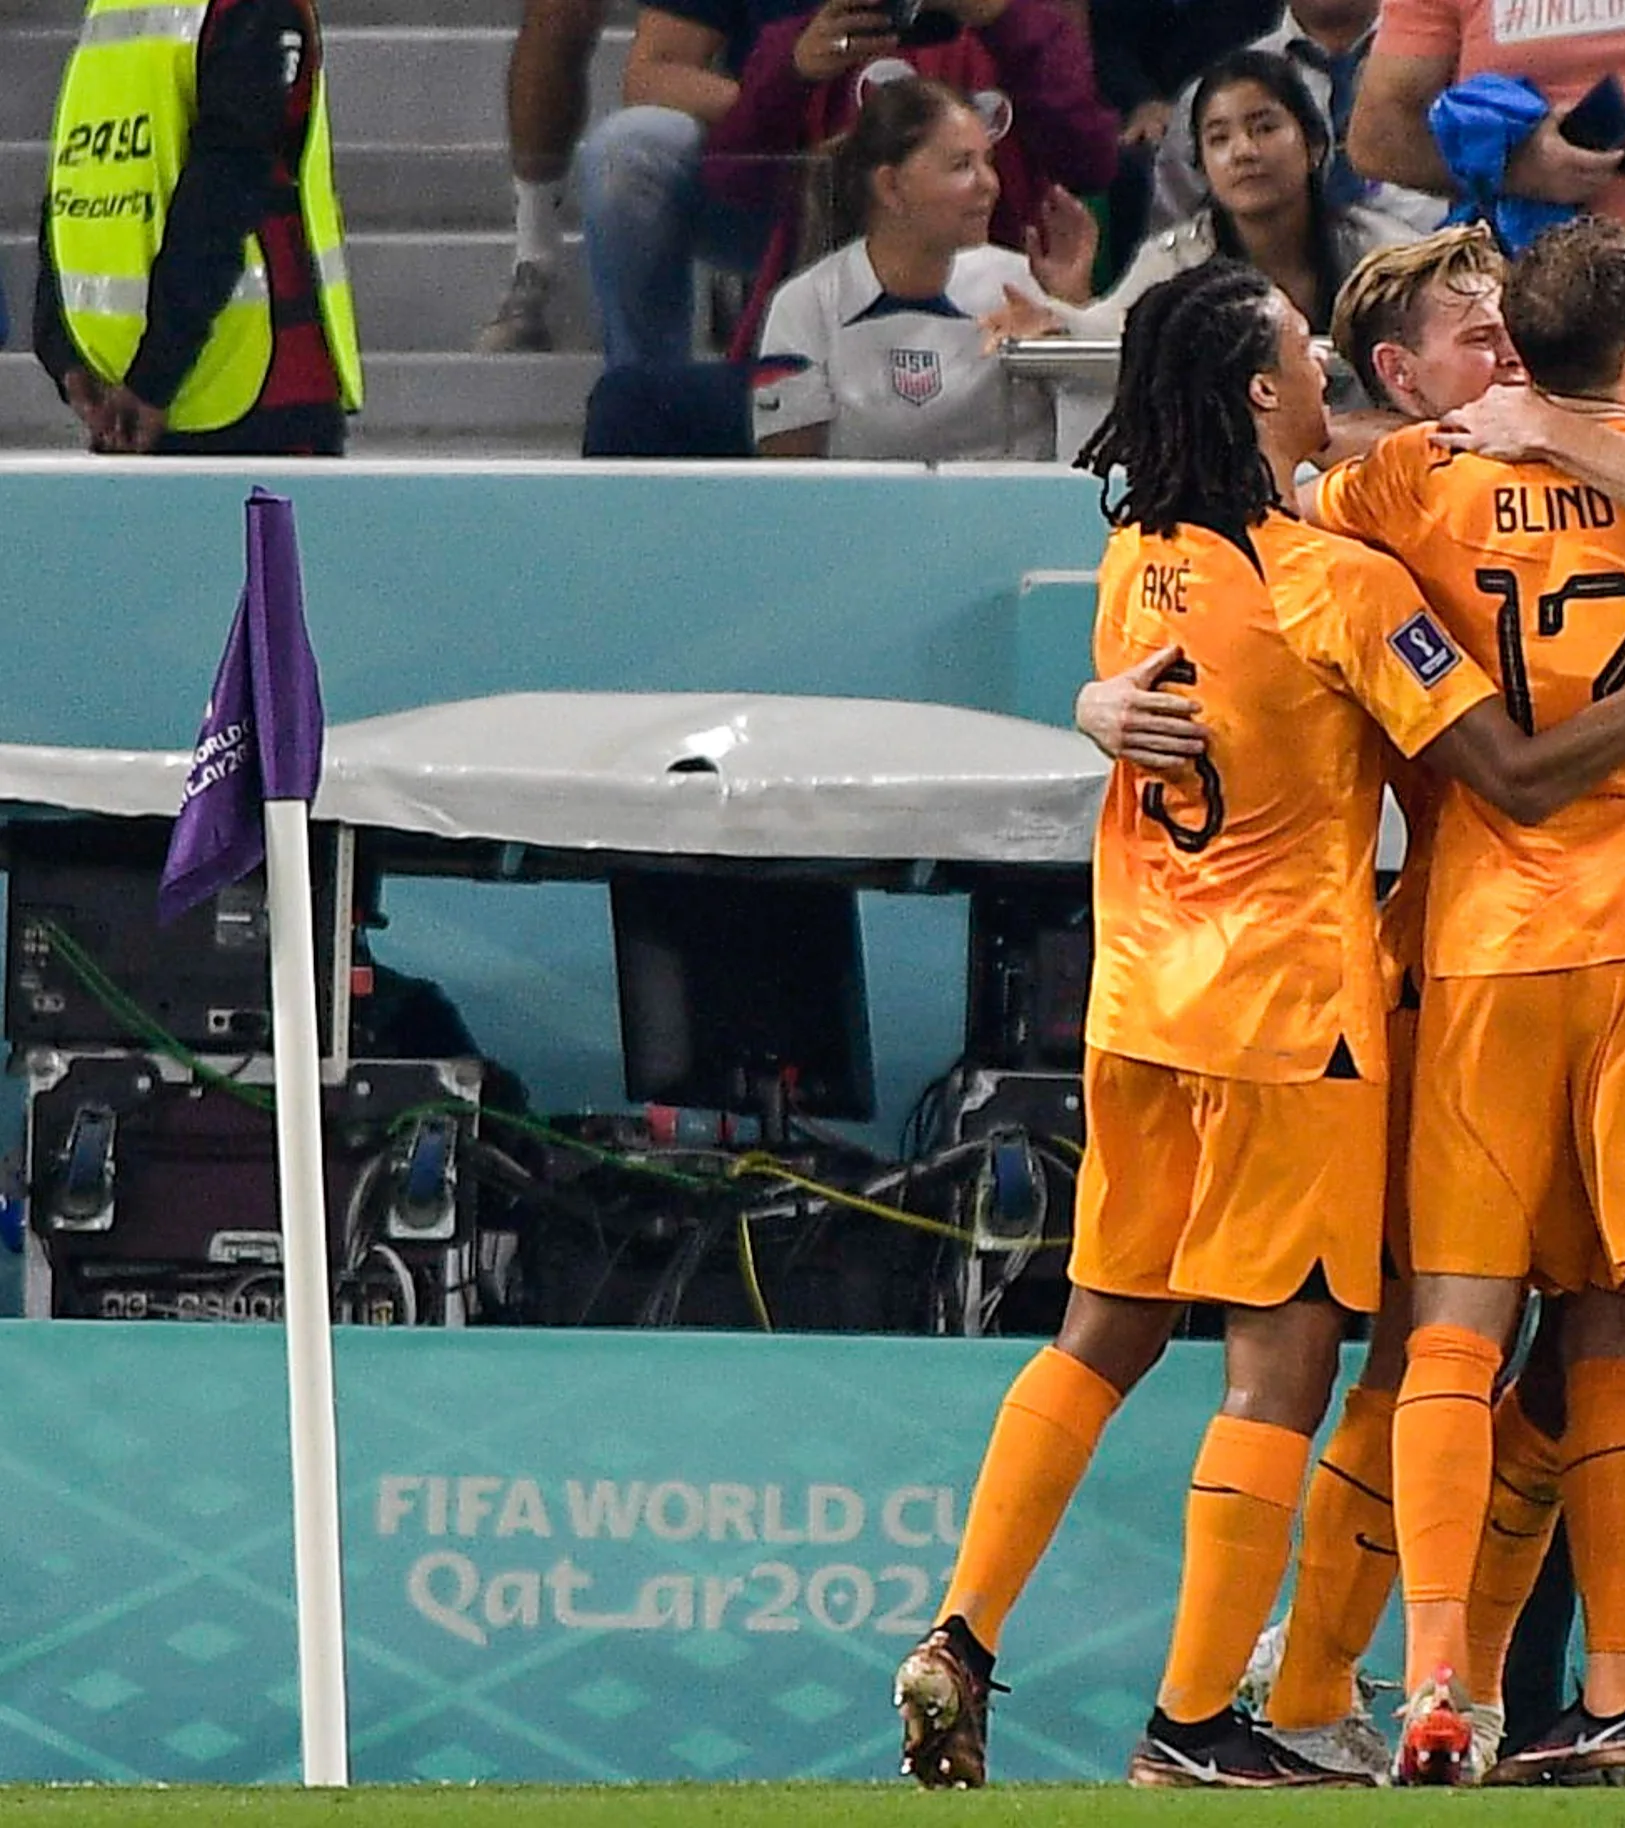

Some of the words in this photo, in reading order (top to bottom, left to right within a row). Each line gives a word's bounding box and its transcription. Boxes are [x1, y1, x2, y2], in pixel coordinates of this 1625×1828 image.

[54, 188, 154, 223] Securty
[896, 353, 932, 373] USA
[1494, 486, 1616, 533] BLIND
[1142, 558, 1190, 613] AKÉ
[376, 1475, 552, 1538] FIFA
[565, 1479, 866, 1543] WORLD
[882, 1484, 961, 1547] CU
[408, 1551, 956, 1648] Qatar202
